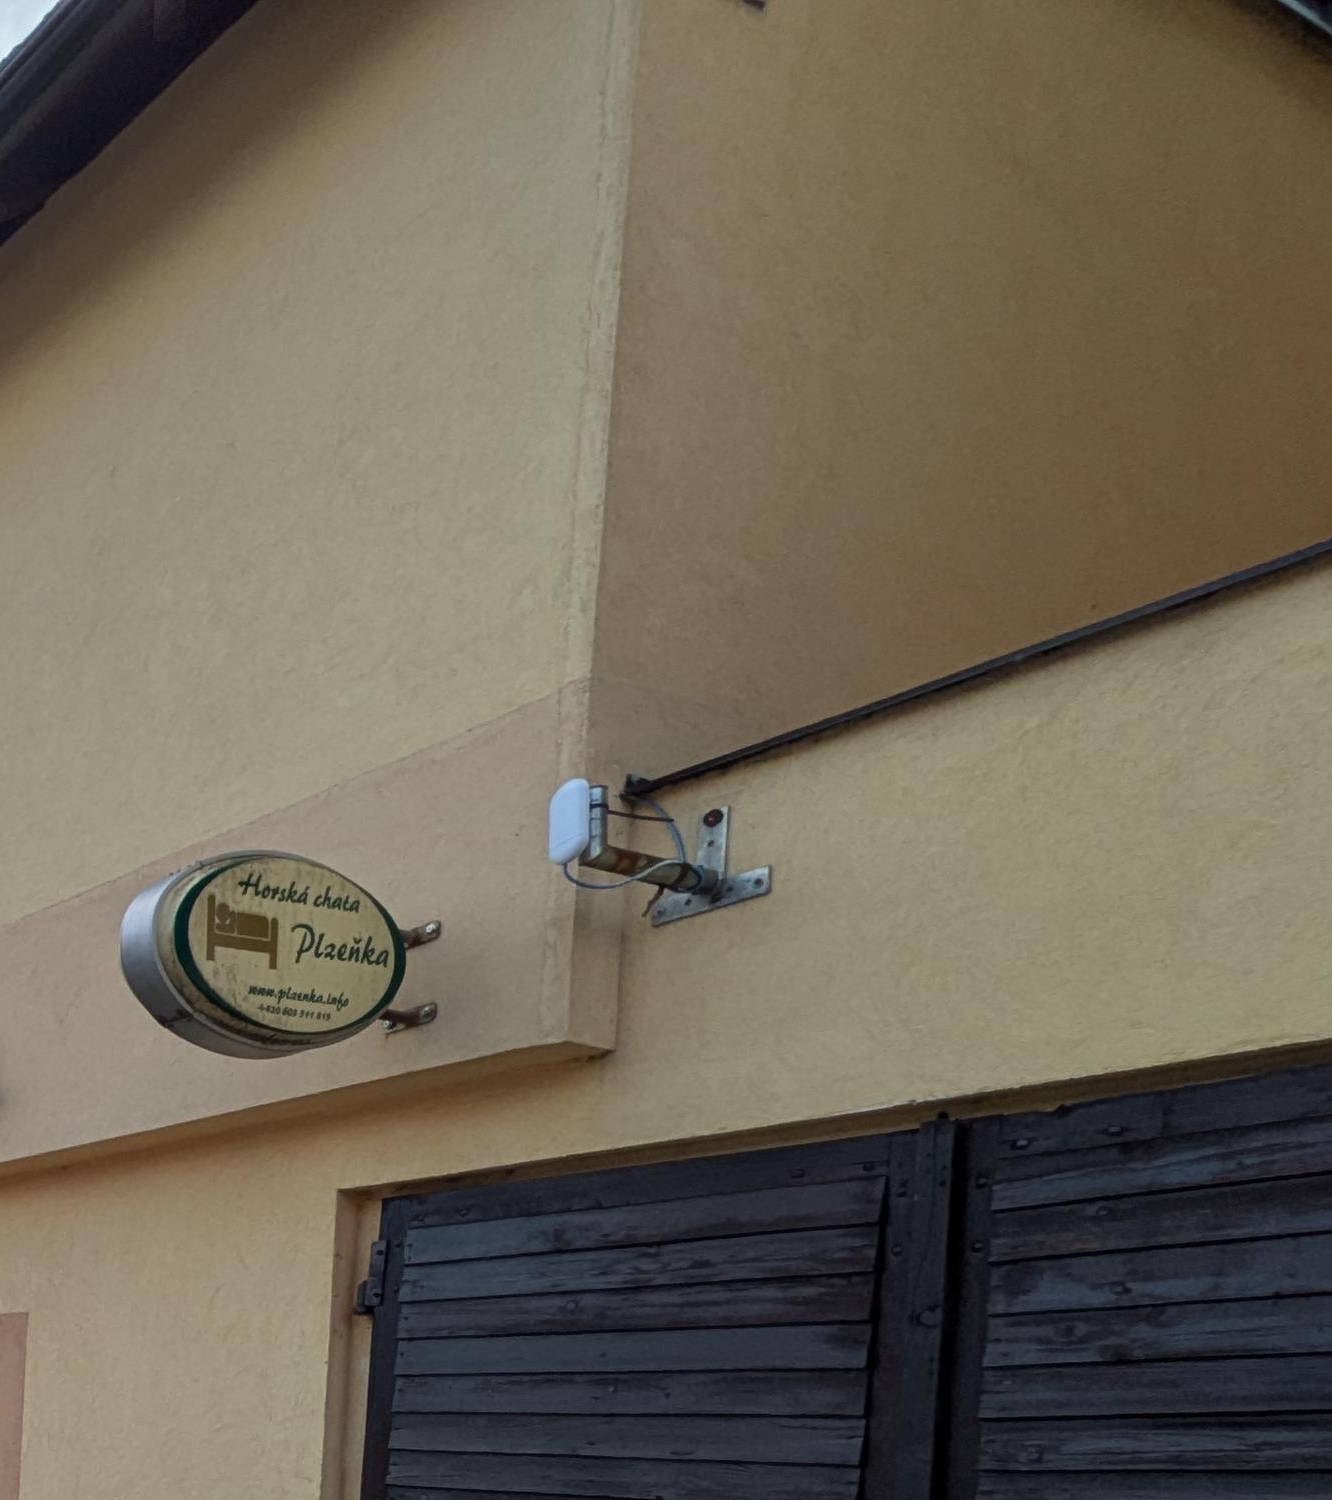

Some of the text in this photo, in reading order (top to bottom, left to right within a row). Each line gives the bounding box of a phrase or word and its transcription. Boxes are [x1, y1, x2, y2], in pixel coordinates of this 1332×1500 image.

[238, 872, 361, 914] Horská chata
[291, 923, 391, 968] Plzeňka
[248, 985, 349, 1011] www.plzenka.info
